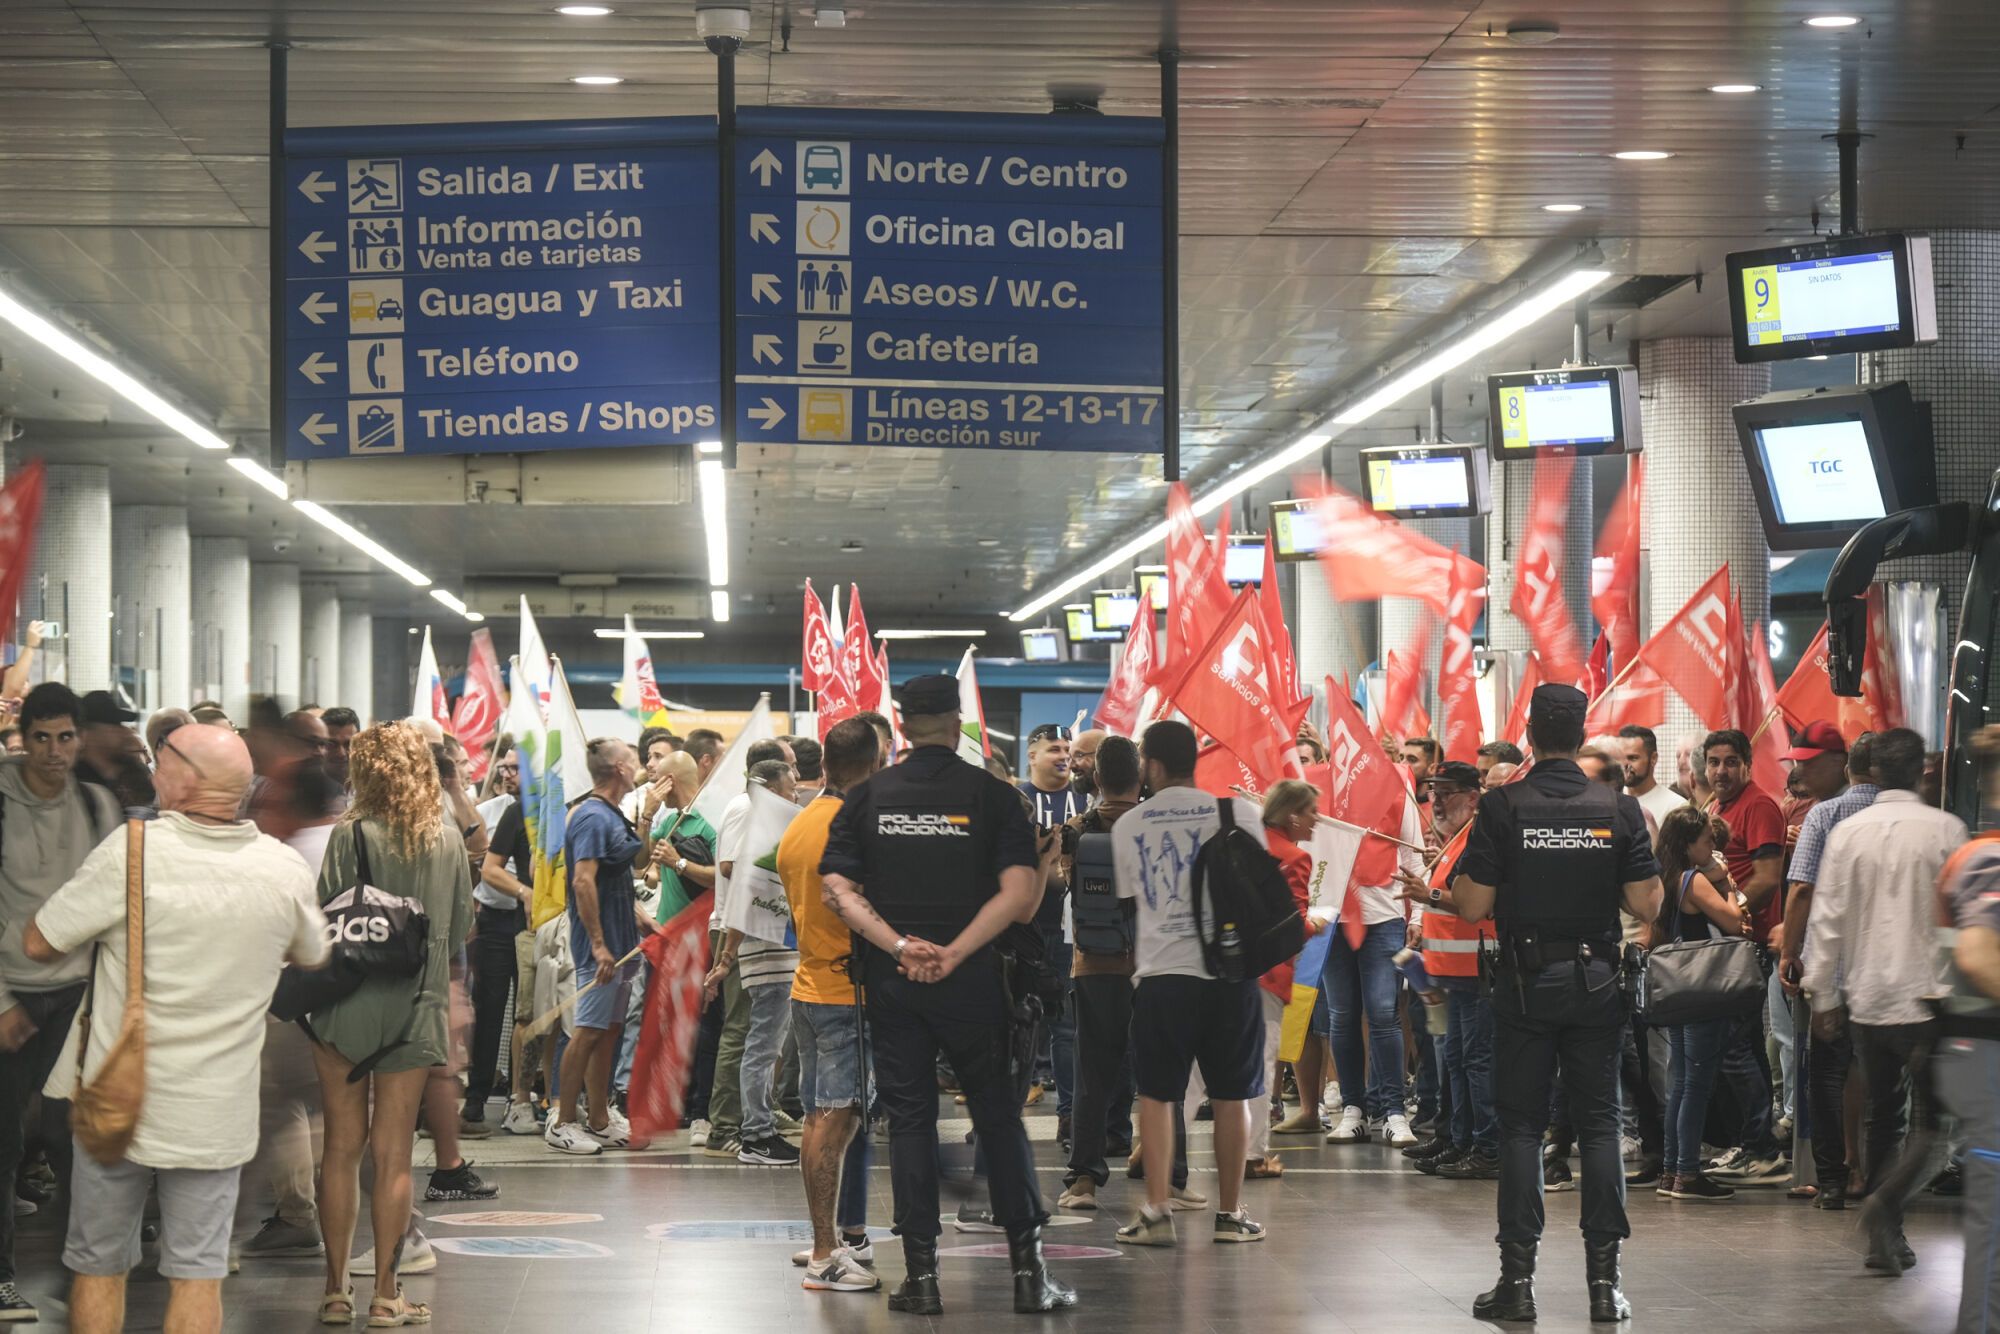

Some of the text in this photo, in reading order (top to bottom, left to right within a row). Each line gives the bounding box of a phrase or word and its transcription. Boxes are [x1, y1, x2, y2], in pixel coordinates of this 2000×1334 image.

[418, 165, 532, 197] Salida
[573, 162, 644, 191] Exit
[867, 153, 969, 185] Norte
[1001, 156, 1128, 189] Centro
[418, 210, 642, 245] Información
[865, 214, 1124, 250] Oficina Global
[418, 243, 641, 269] Venta de tarjetas
[864, 276, 978, 307] Aseos
[1007, 279, 1088, 309] W.C.
[1754, 278, 1769, 308] 9
[1808, 272, 1842, 285] SIN DATOS
[419, 279, 683, 320] Guagua y Taxi
[418, 346, 579, 377] Teléfono
[866, 331, 1039, 364] Cafetería
[418, 405, 569, 438] Tiendas
[599, 401, 715, 434] Shops
[867, 389, 1159, 426] Líneas 12-13-17
[1509, 396, 1520, 419] 8
[867, 422, 1041, 447] Dirección sur
[1376, 468, 1386, 486] 7
[1808, 459, 1844, 474] TGC
[1210, 661, 1261, 708] servicios
[878, 814, 951, 825] POLICIA
[1035, 791, 1079, 829] GA
[878, 824, 970, 836] NACIONAL
[1523, 828, 1595, 838] POLICIA
[1523, 839, 1613, 849] NACIONAL
[1085, 879, 1109, 892] LiveU
[751, 895, 789, 918] trabaja
[325, 913, 390, 943] das
